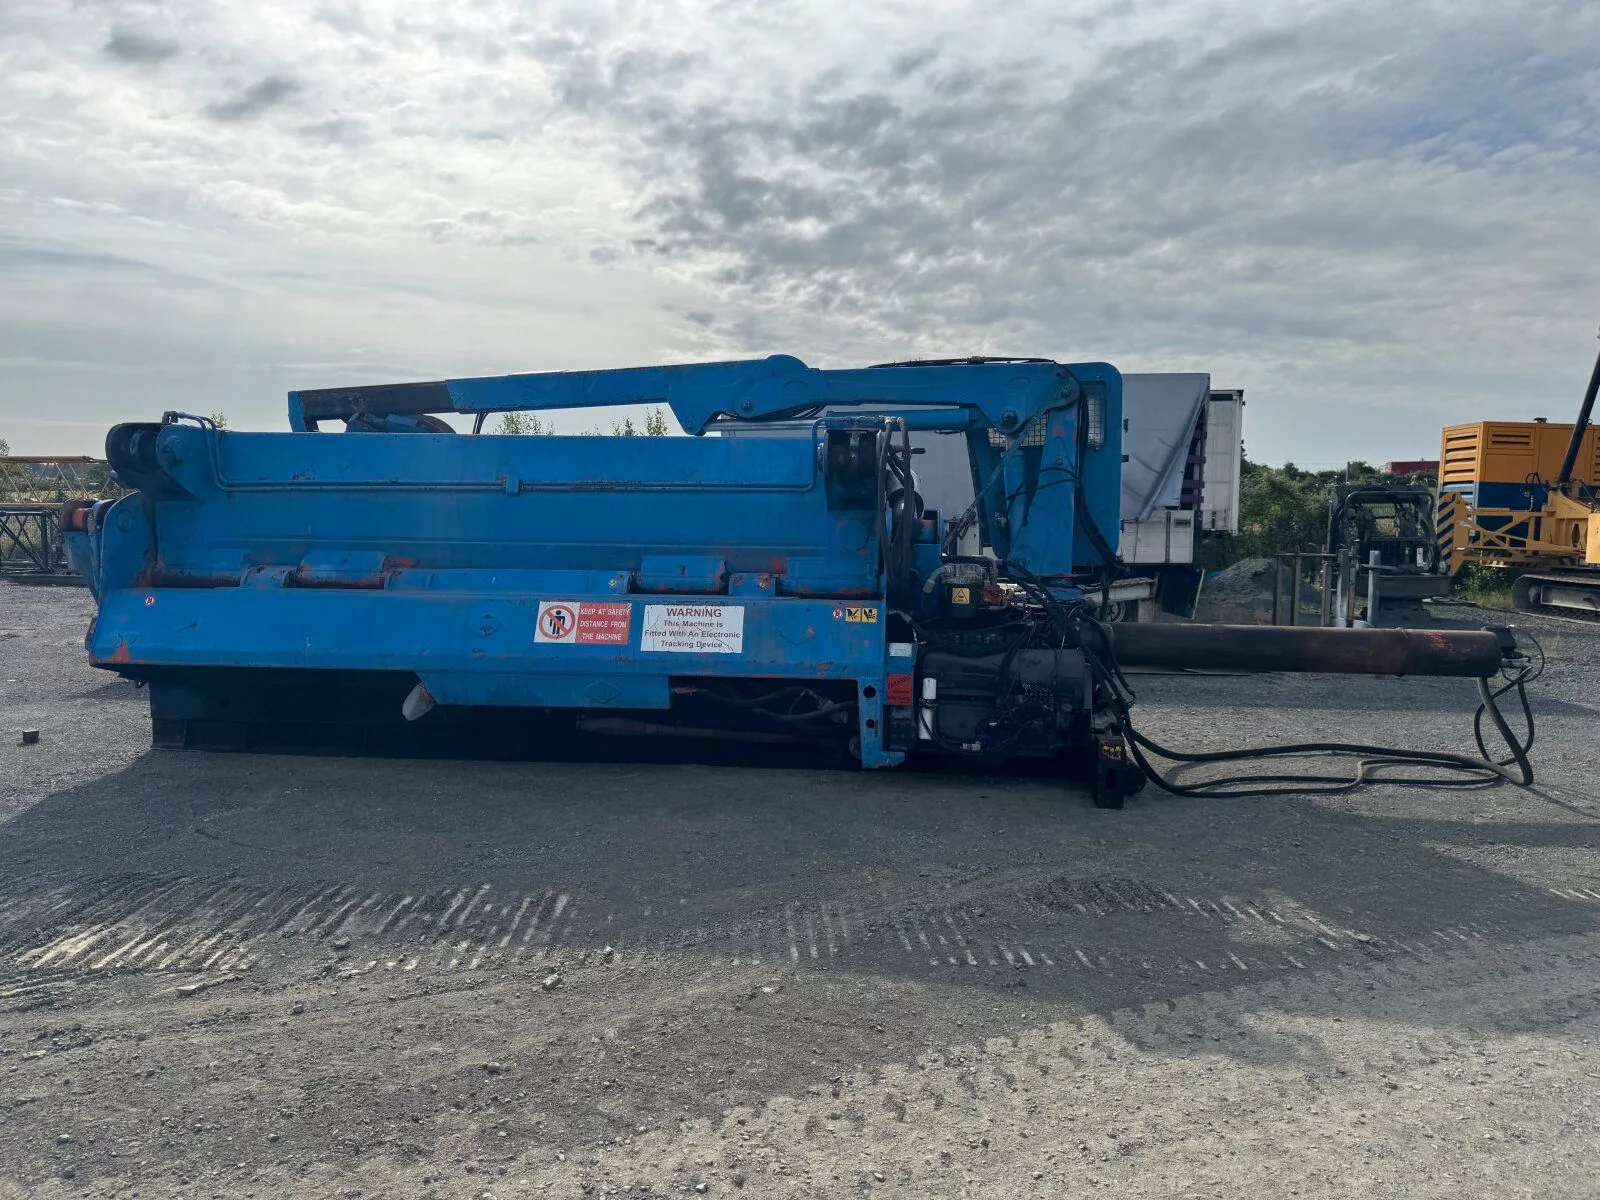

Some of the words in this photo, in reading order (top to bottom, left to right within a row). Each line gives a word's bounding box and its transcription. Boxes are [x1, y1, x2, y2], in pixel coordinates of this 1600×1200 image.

[608, 608, 631, 616] SAFETY
[666, 608, 722, 618] WARNING
[580, 620, 608, 628] DISTANCE
[682, 620, 715, 628] Machine
[582, 632, 594, 640] THE
[596, 633, 622, 641] MACHINE
[644, 629, 667, 637] Fitted
[688, 630, 699, 638] An
[701, 630, 741, 639] Electronic
[661, 640, 694, 649] Tracking
[696, 640, 723, 649] Device
